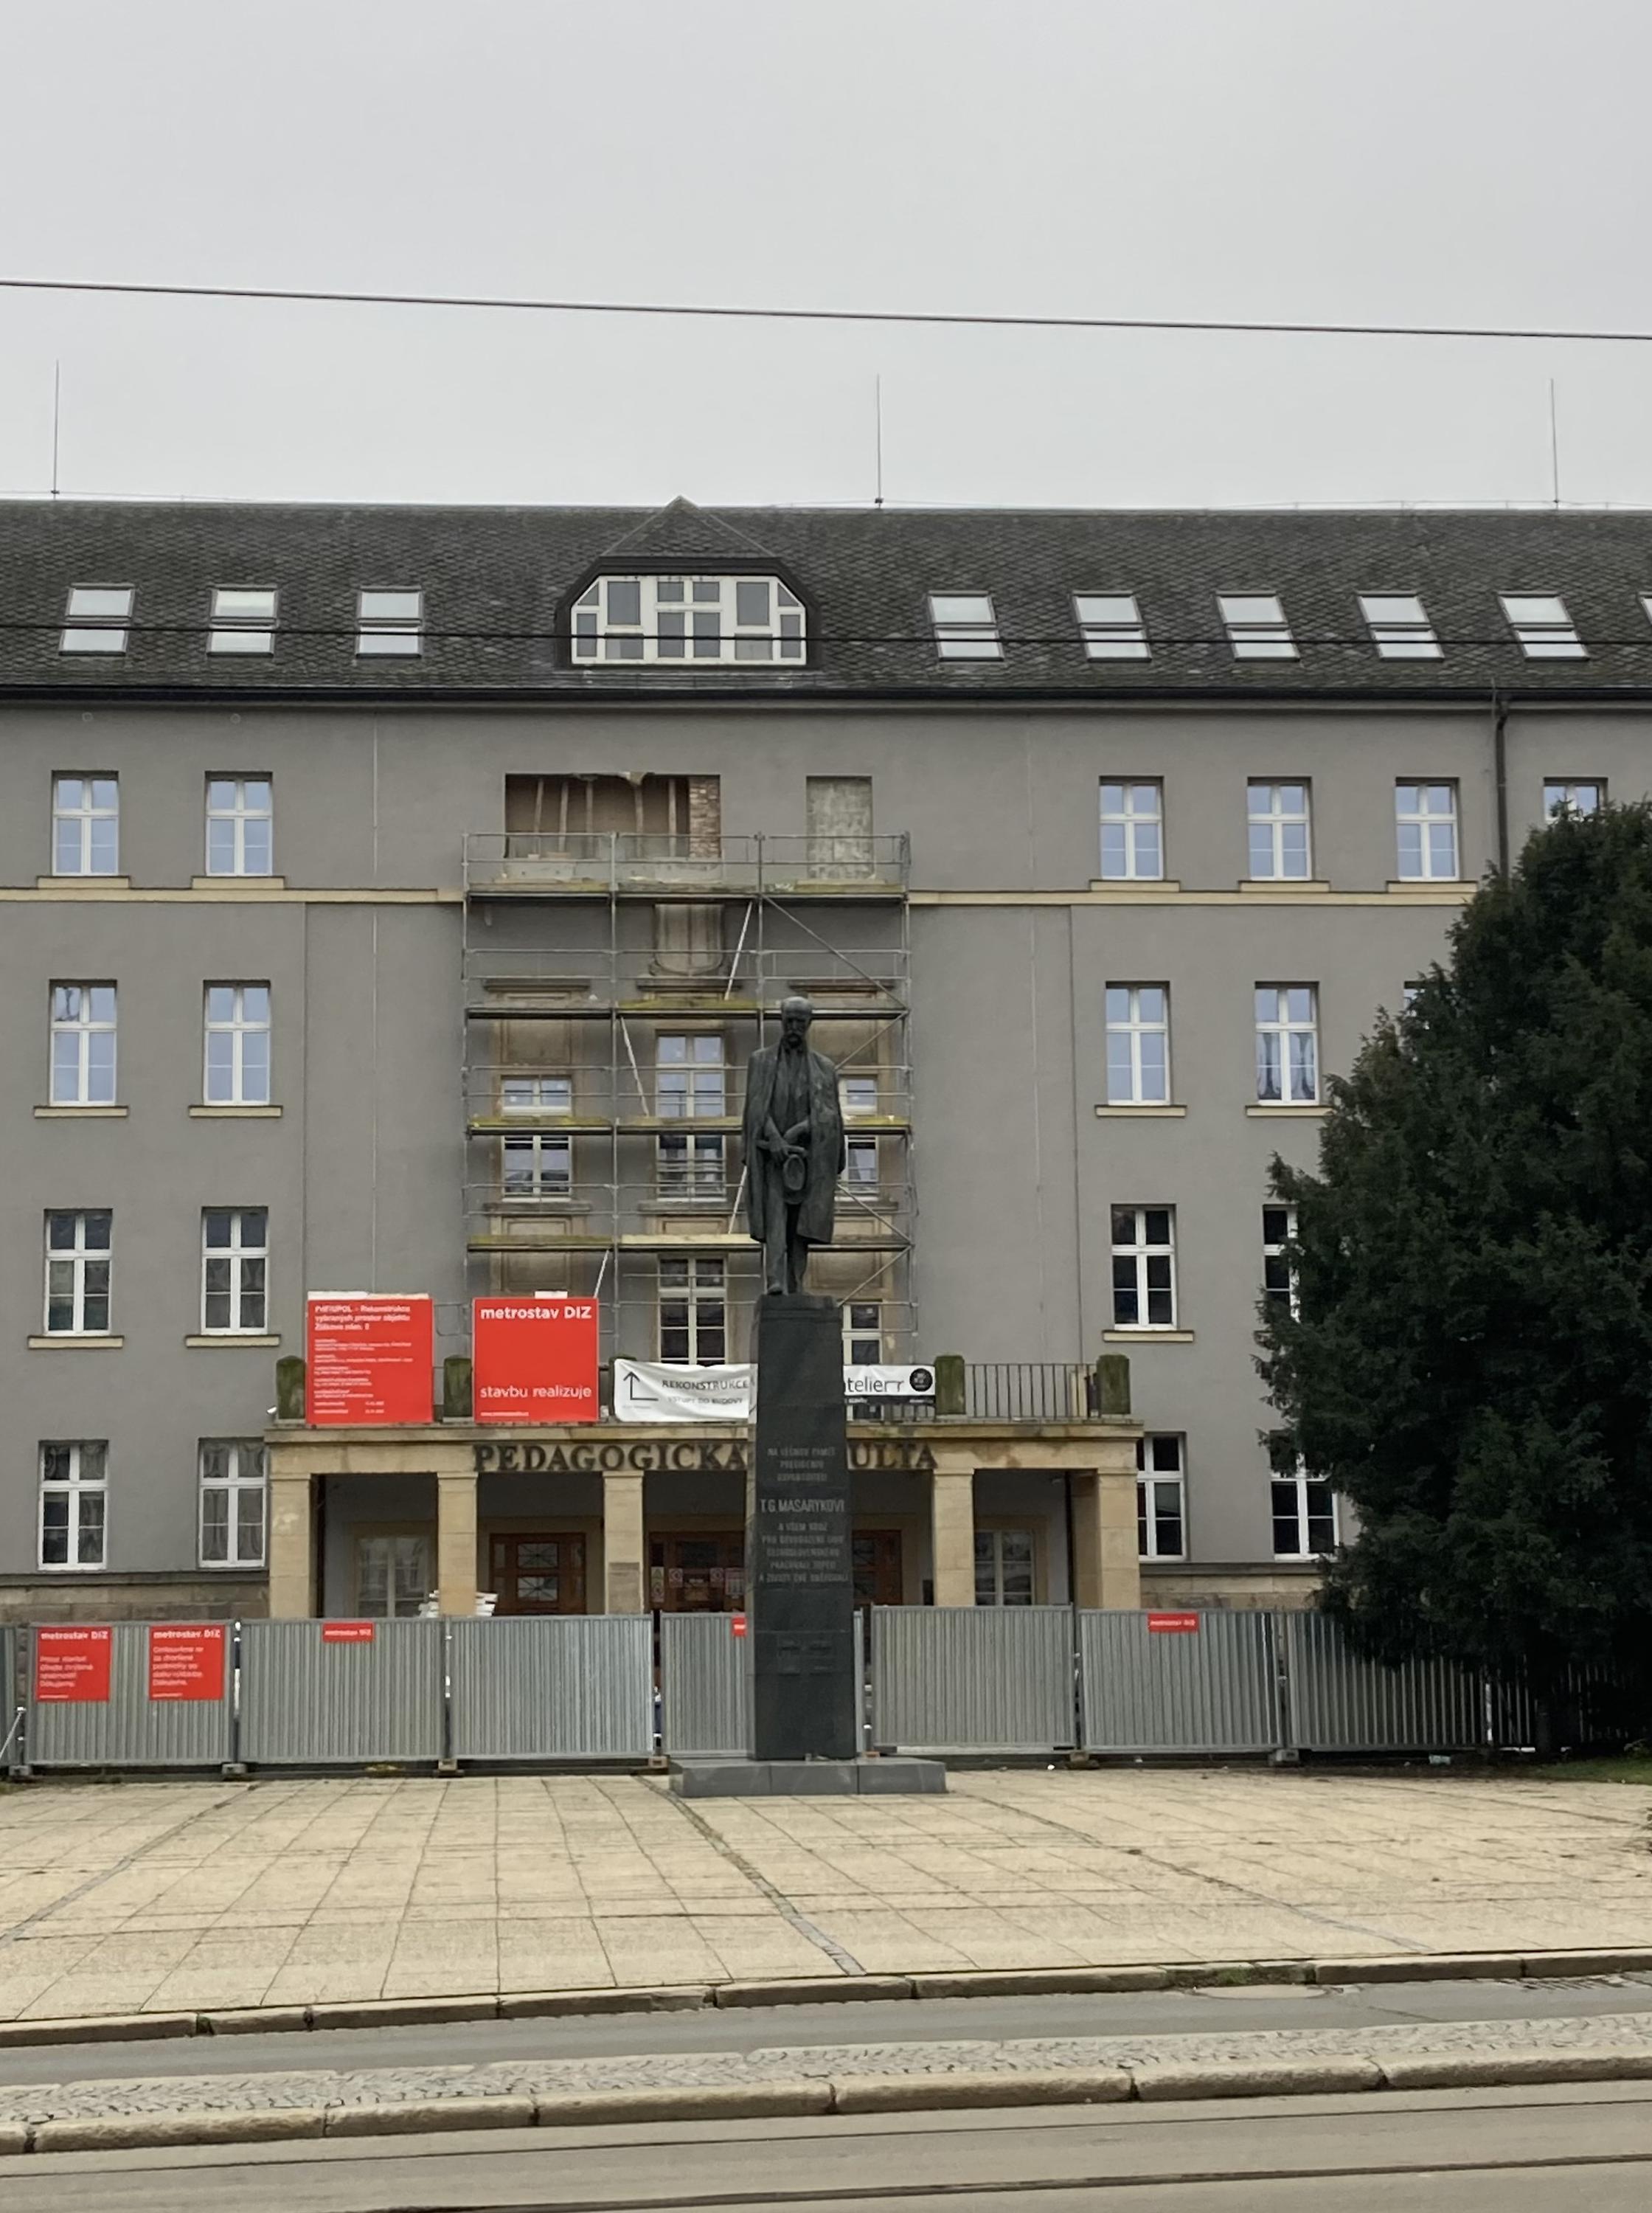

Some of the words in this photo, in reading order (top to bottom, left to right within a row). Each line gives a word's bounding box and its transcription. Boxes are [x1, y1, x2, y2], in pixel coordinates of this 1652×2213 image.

[480, 1306, 559, 1319] metrostav
[563, 1306, 591, 1319] DIZ
[662, 1379, 749, 1391] REKONSTRUKCE
[480, 1385, 528, 1399] stavbu
[532, 1384, 591, 1400] realizuje
[848, 1442, 938, 1469] ULTA
[91, 1631, 108, 1639] DIZ
[153, 1631, 201, 1639] metrostav
[204, 1629, 221, 1638] DIZ
